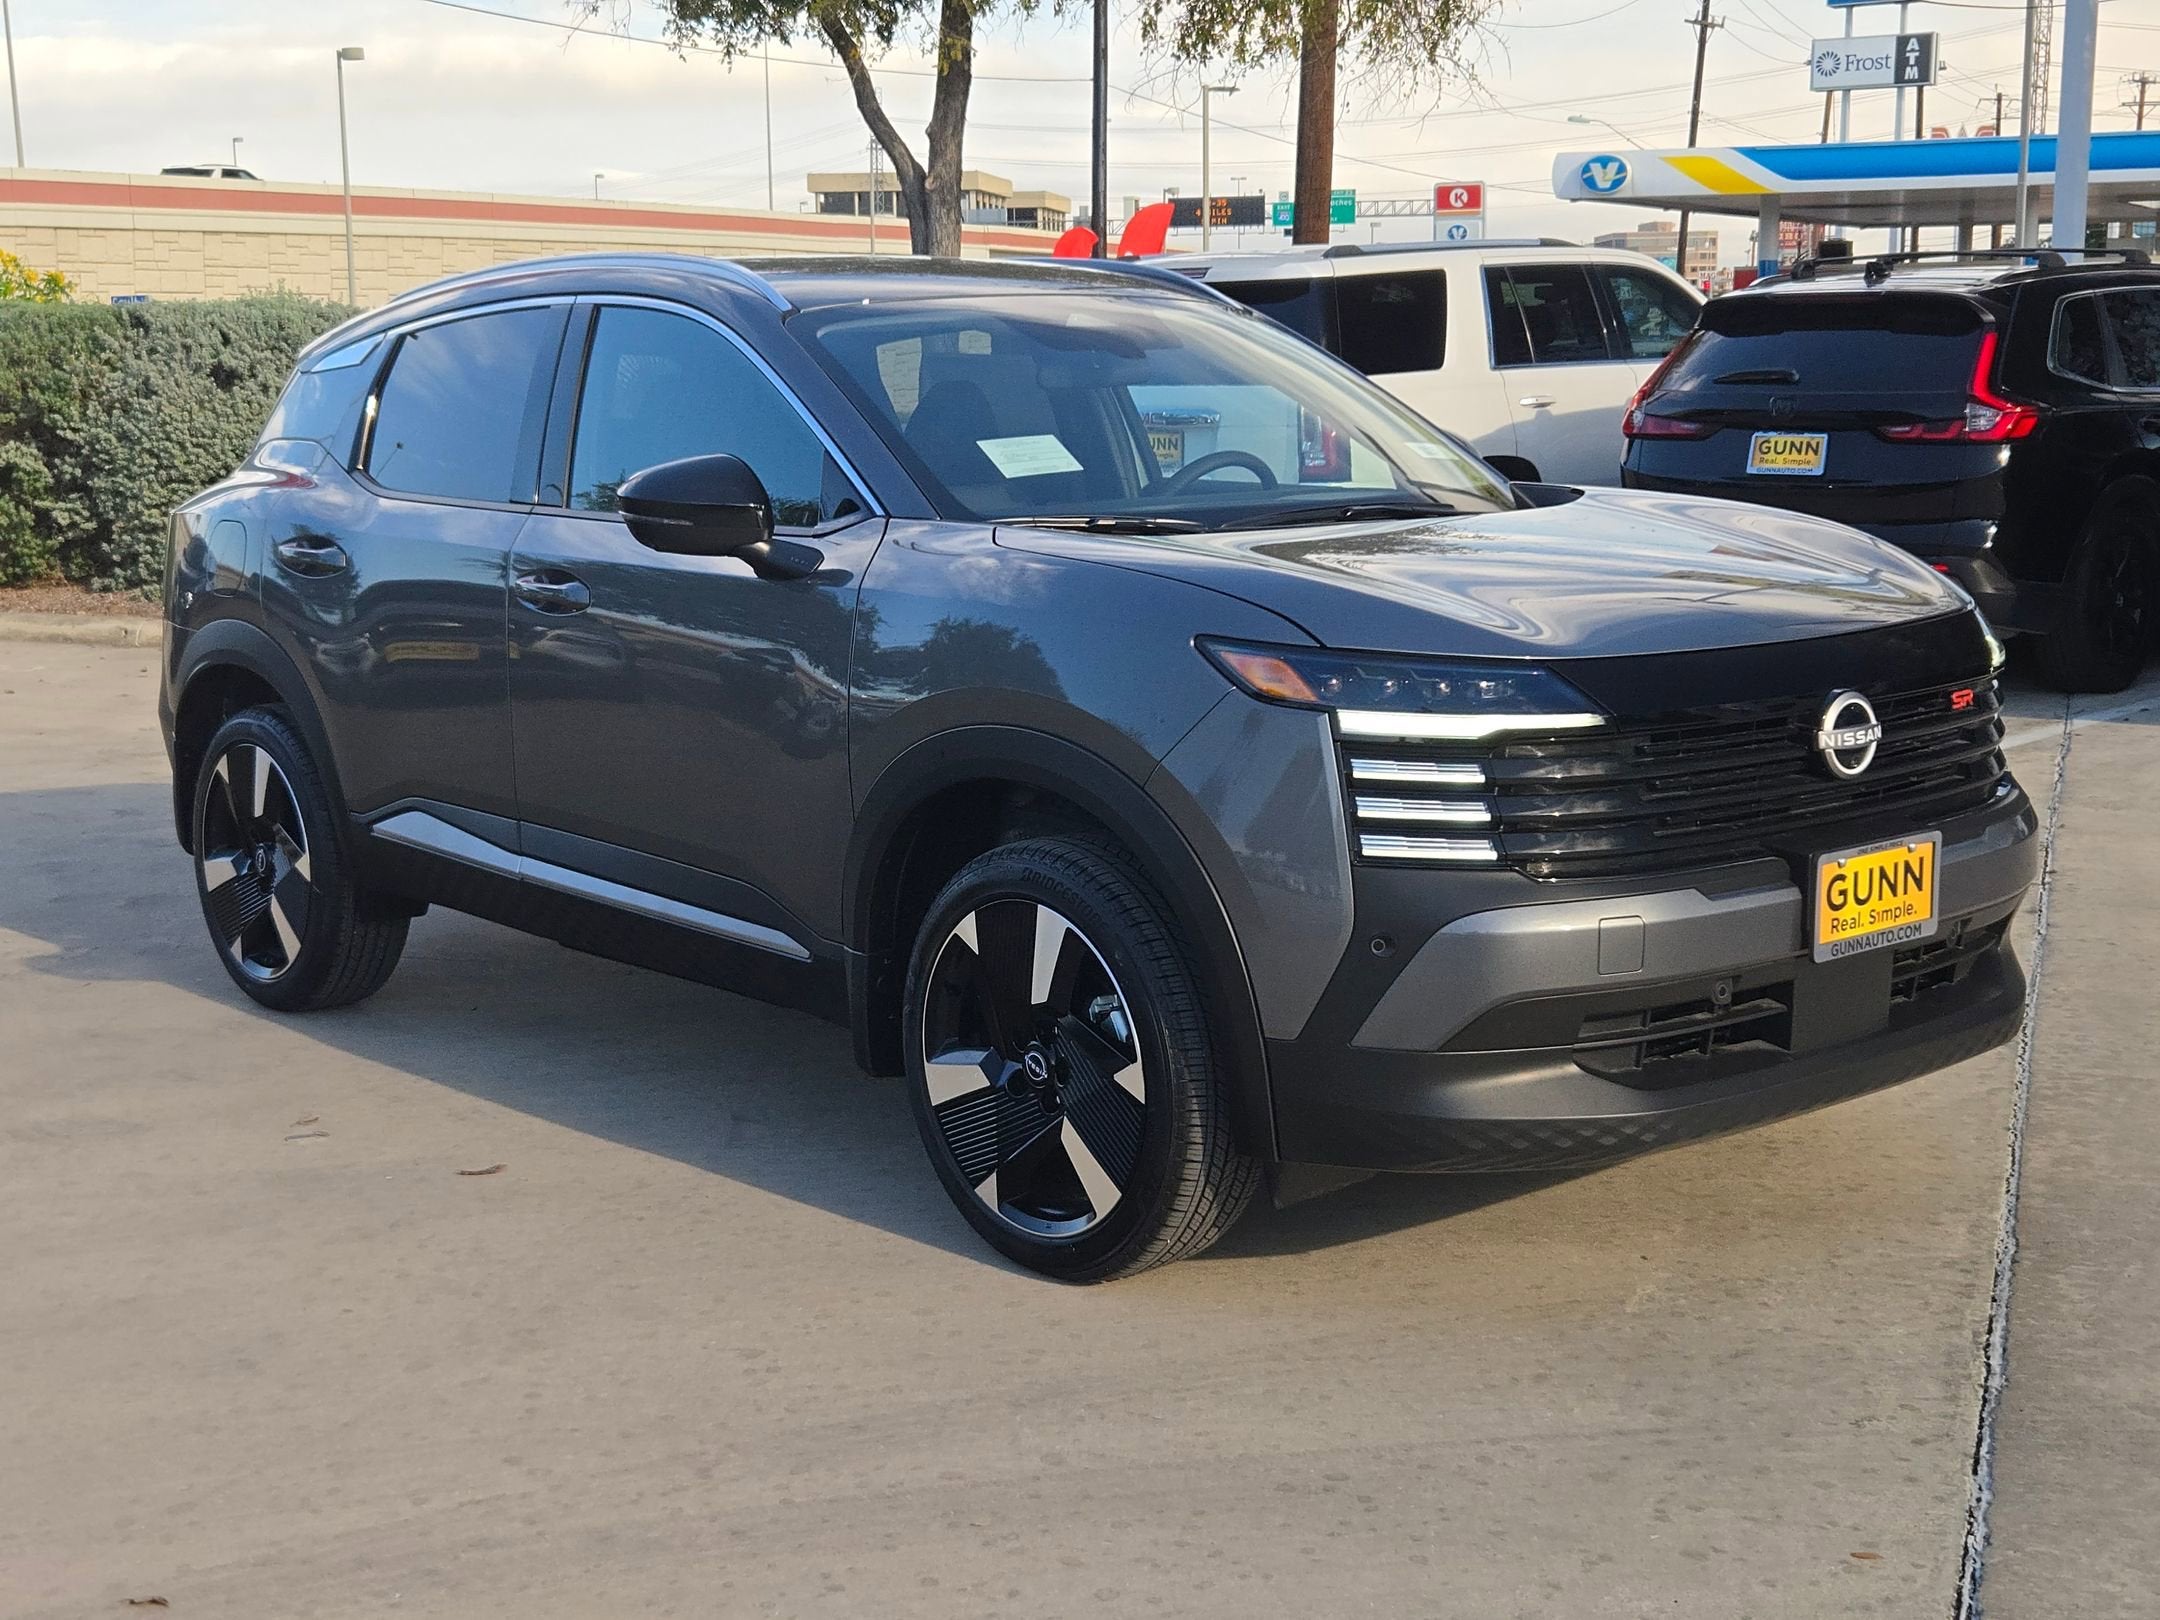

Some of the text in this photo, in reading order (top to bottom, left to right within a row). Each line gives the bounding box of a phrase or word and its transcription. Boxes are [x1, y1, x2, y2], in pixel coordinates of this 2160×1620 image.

[1844, 53, 1892, 72] Frost
[1904, 38, 1920, 79] ATM
[1150, 437, 1178, 450] UNN
[1759, 439, 1819, 456] GUNN
[1952, 689, 1973, 710] SR
[1822, 724, 1882, 748] NISSAN
[1826, 856, 1924, 912] GUNN
[1831, 911, 1864, 934] Real.
[1831, 922, 1922, 957] GUNNAUTO.COM
